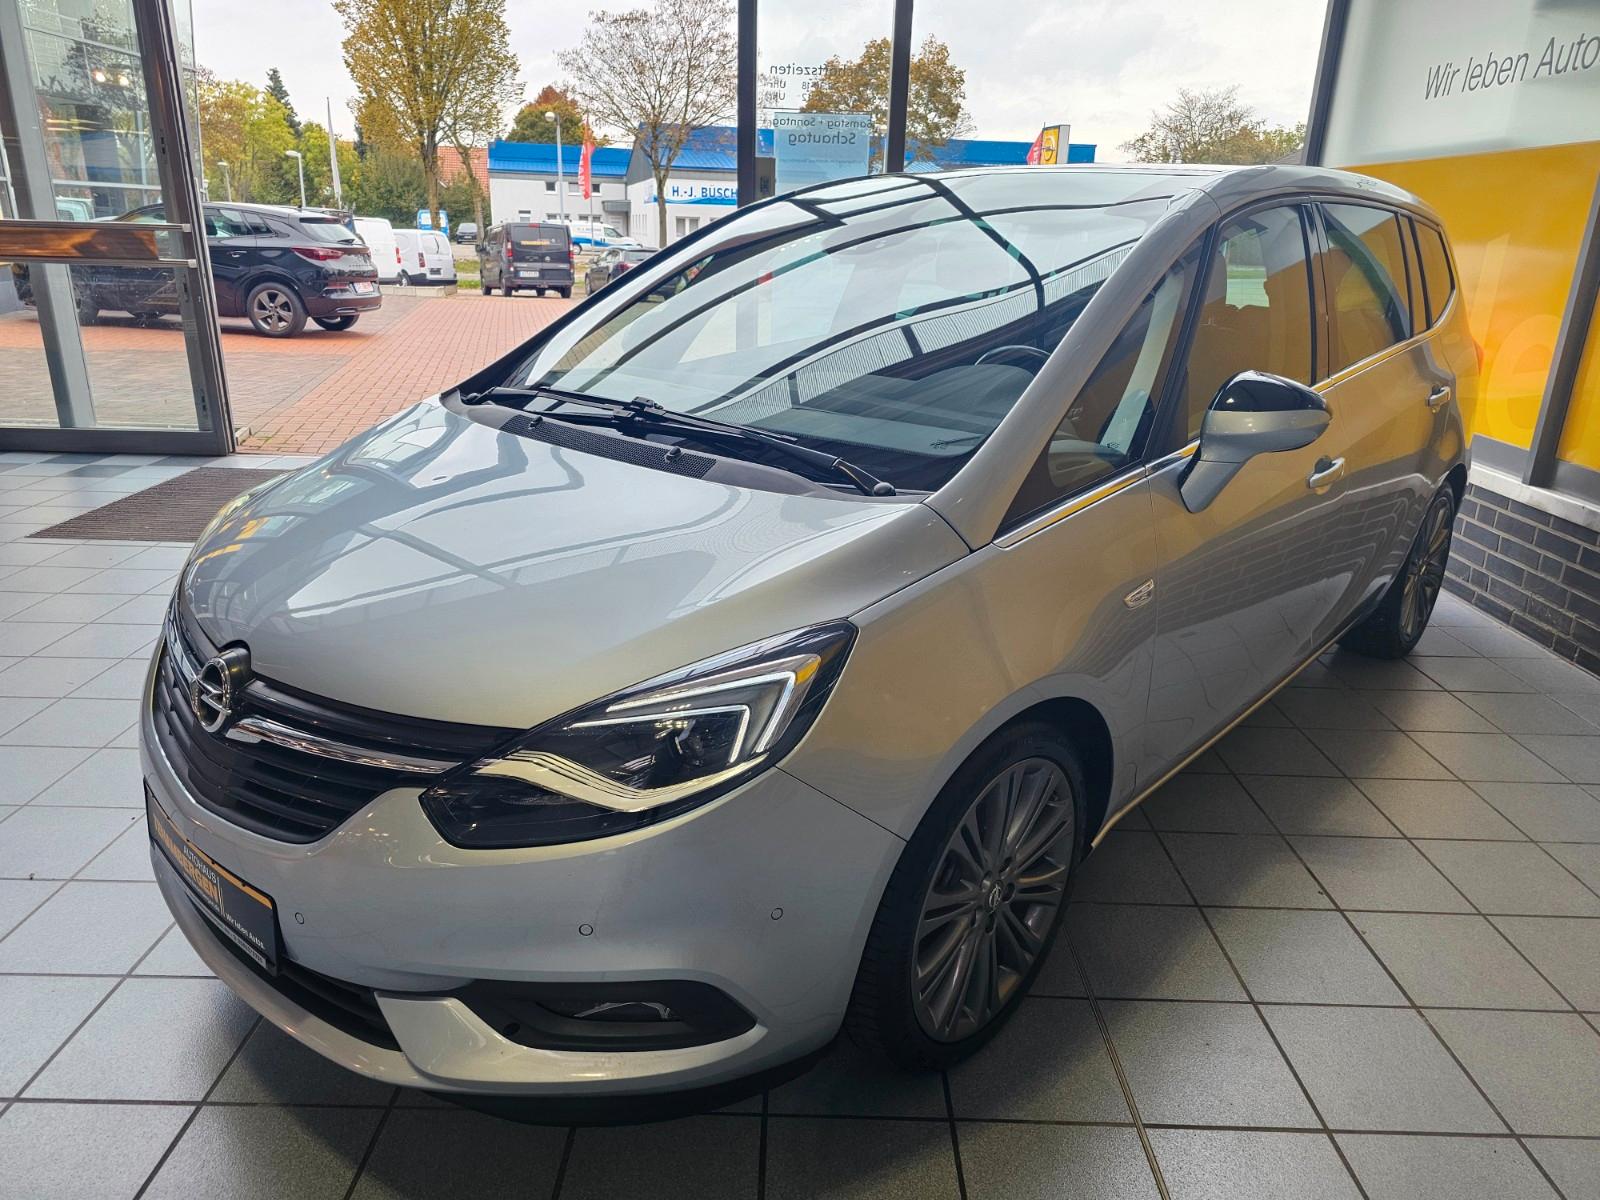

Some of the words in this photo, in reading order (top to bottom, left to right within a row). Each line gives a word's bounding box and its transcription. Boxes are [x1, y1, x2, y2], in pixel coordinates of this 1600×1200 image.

[1425, 62, 1460, 100] Wir
[1461, 51, 1529, 93] leben
[1533, 33, 1600, 79] Auto
[672, 186, 697, 198] H.-J.
[183, 845, 217, 884] AUTOHAUS
